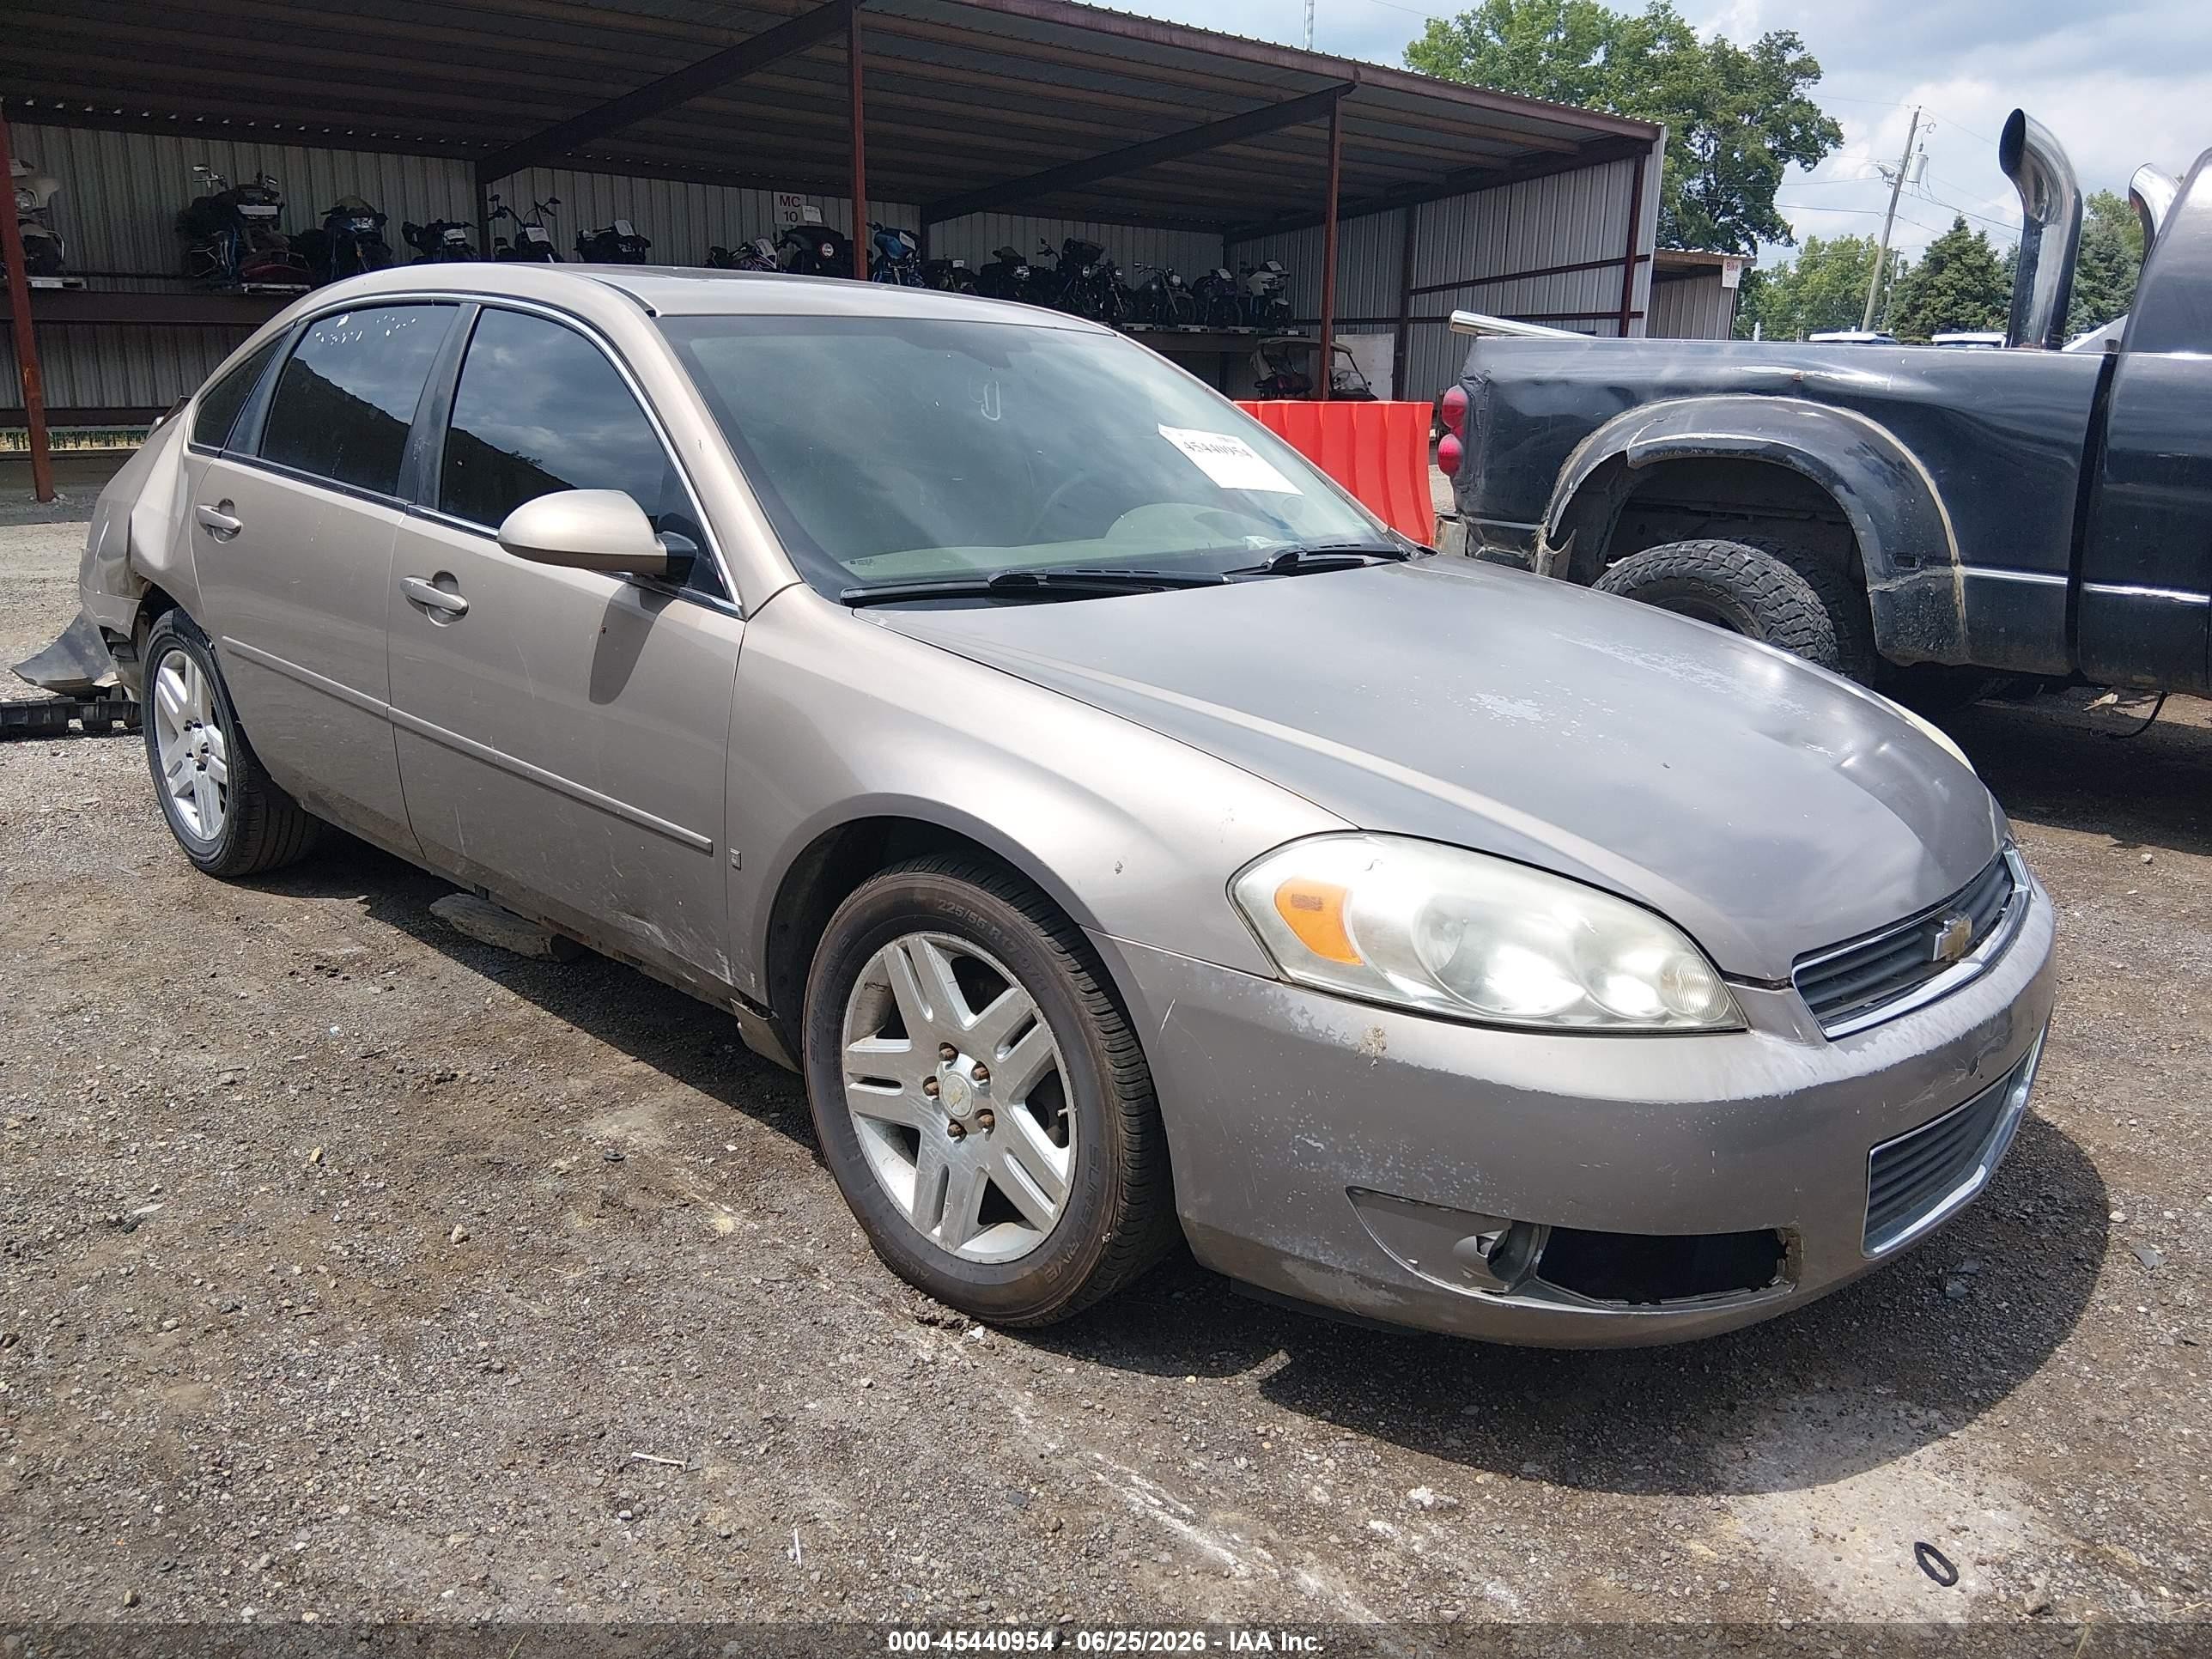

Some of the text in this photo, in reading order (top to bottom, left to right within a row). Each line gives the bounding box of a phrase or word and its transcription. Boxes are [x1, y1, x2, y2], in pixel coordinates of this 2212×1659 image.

[779, 195, 800, 208] MC
[783, 210, 798, 222] 10
[1726, 261, 1739, 272] Bike
[938, 899, 988, 929] 225/55
